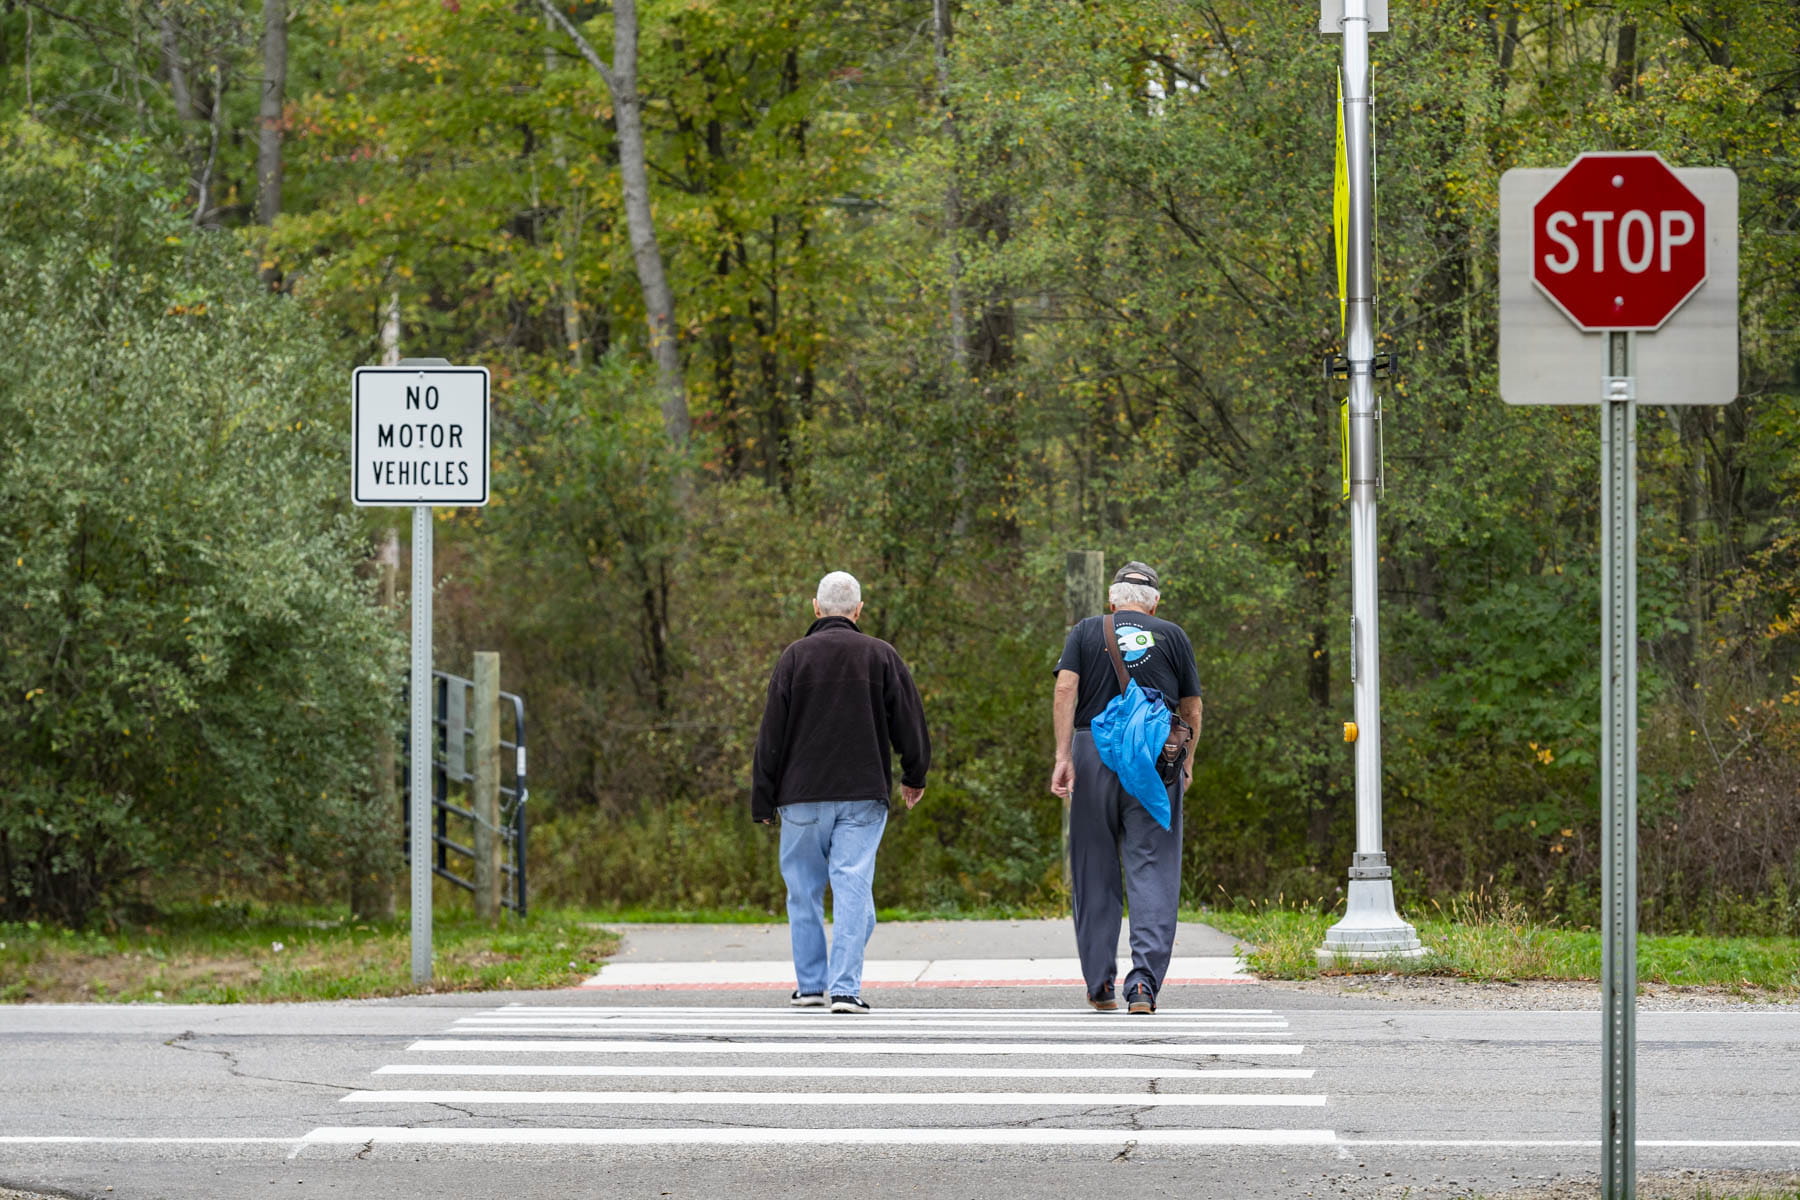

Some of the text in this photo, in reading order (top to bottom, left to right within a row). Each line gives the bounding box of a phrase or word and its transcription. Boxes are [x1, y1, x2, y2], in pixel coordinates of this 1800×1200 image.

[1544, 209, 1695, 274] STOP
[406, 385, 439, 410] NO
[378, 424, 463, 448] MOTOR
[372, 461, 469, 486] VEHICLES
